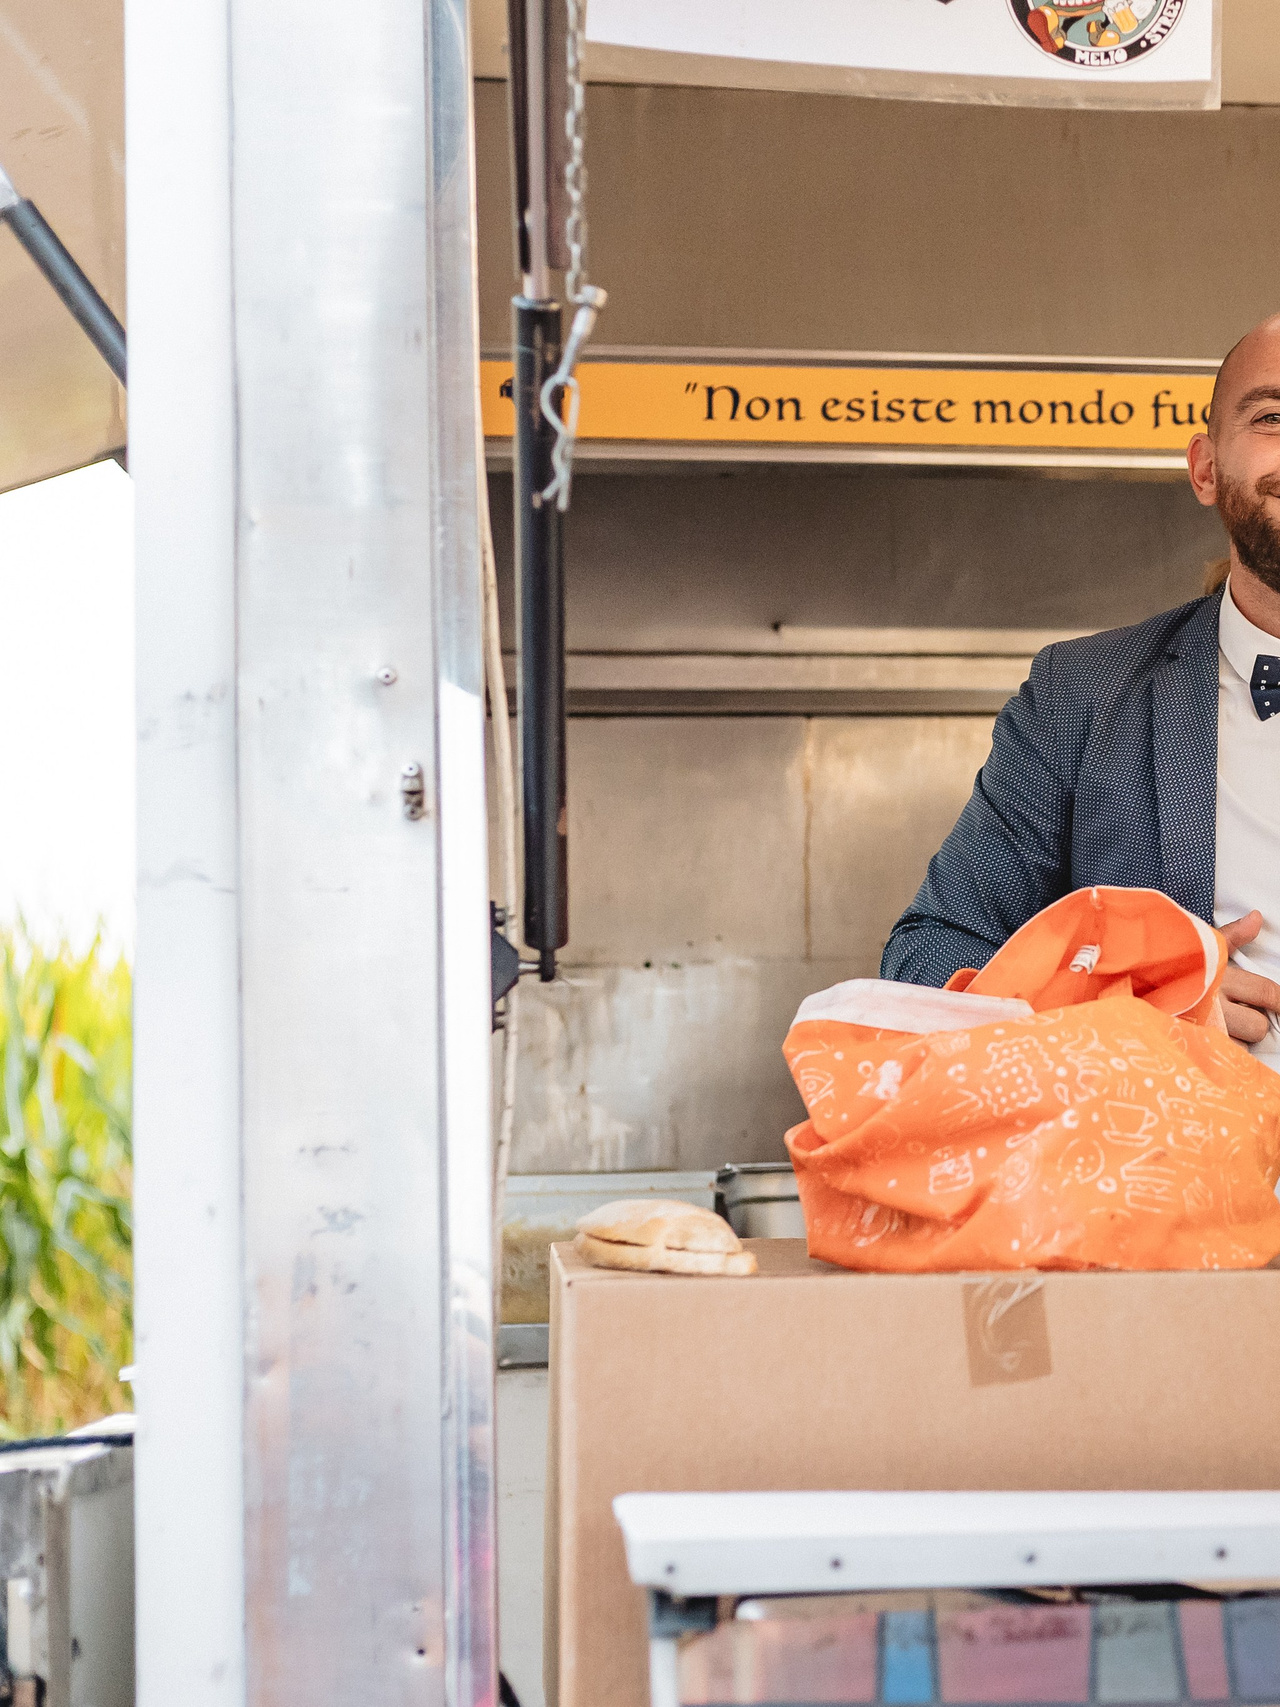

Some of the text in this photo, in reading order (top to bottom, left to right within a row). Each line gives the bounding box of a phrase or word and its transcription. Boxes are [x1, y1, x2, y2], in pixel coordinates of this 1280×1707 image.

[1075, 0, 1182, 65] MELIO STREE
[820, 390, 957, 425] esiste
[973, 389, 1135, 425] mondo
